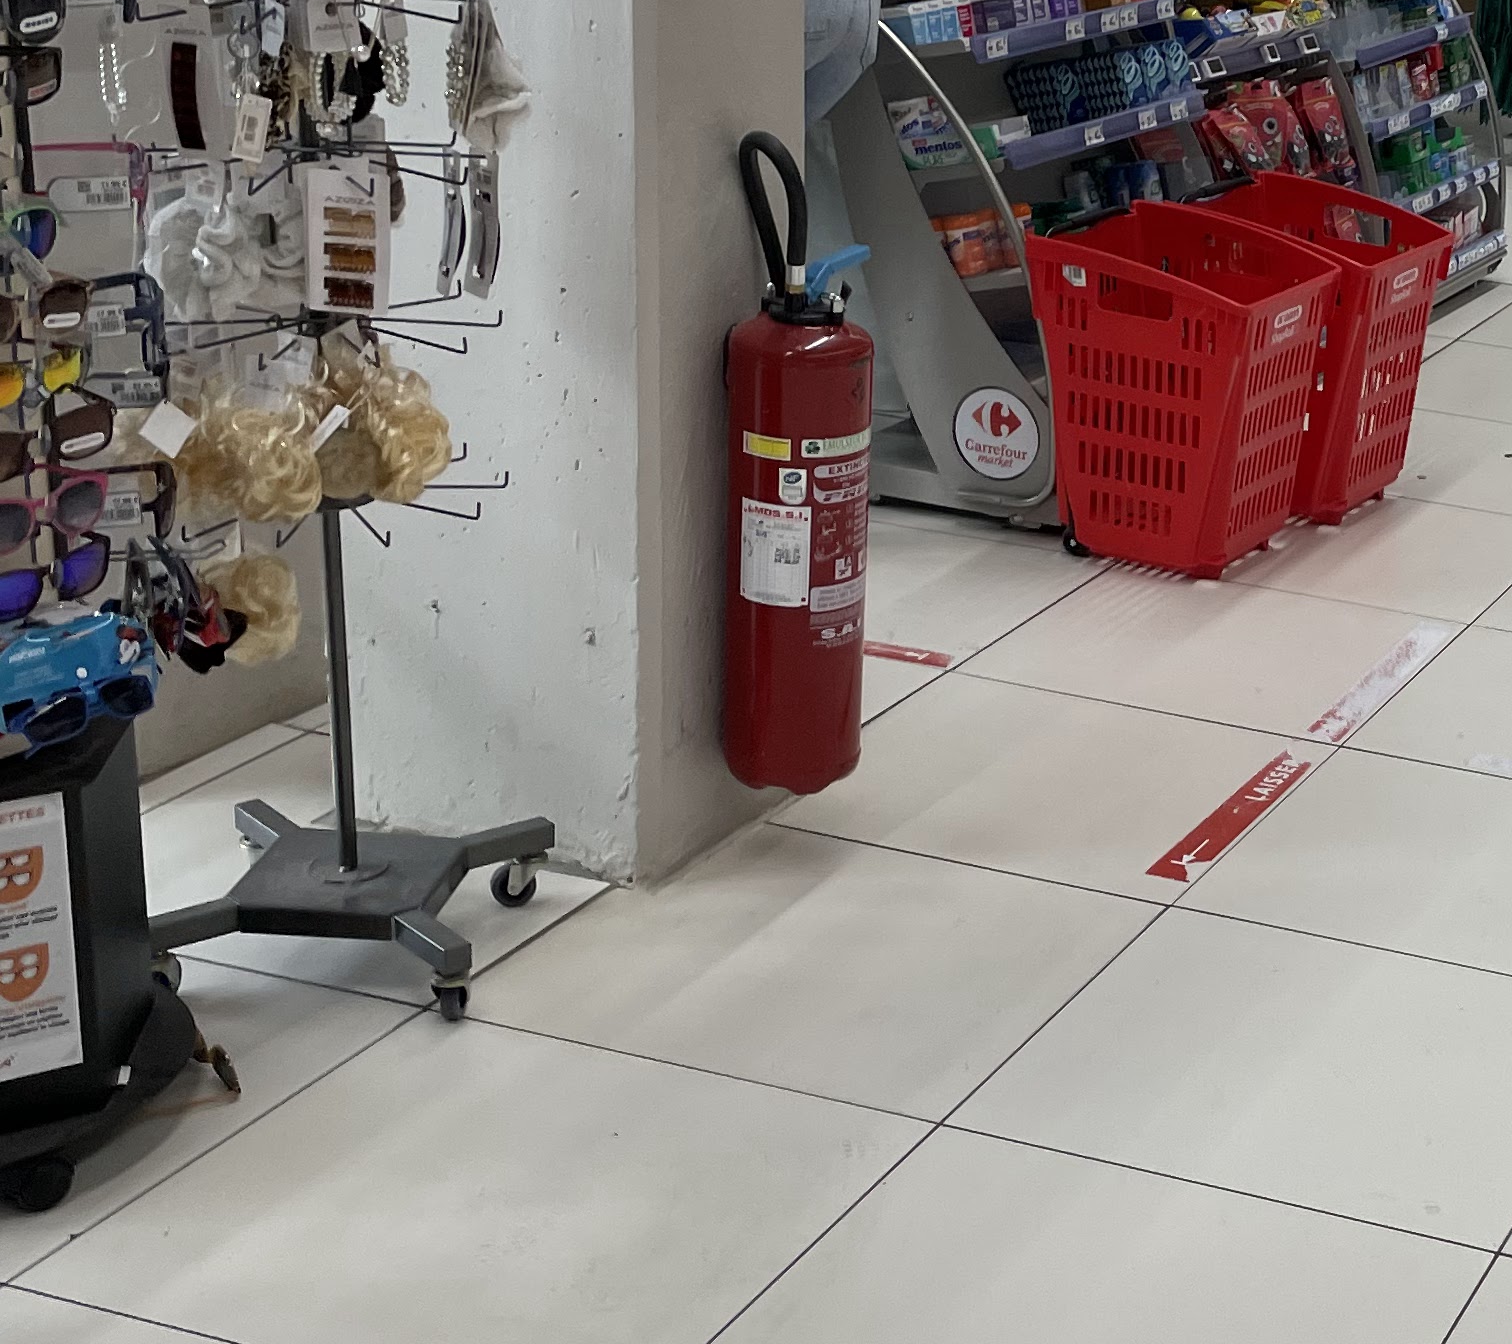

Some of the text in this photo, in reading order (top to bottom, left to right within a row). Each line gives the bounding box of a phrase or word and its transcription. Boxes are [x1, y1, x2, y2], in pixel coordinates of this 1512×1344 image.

[914, 140, 963, 156] mentos
[965, 438, 1028, 461] Carrefour
[977, 454, 1014, 468] market
